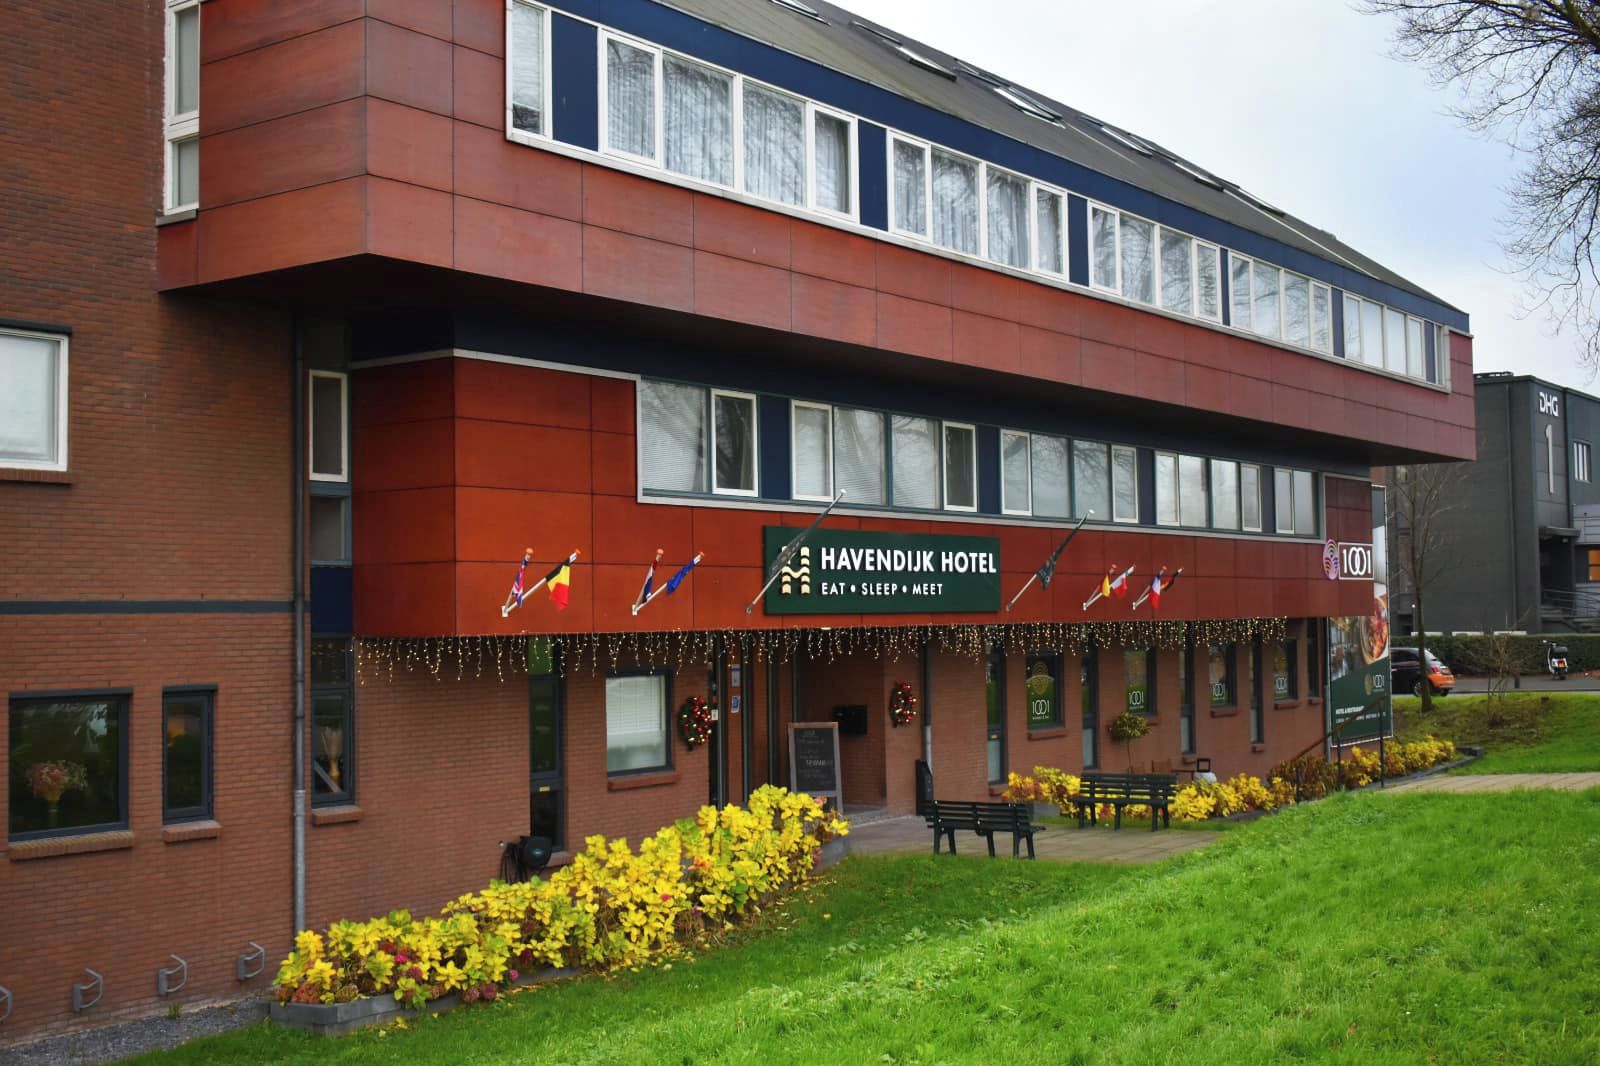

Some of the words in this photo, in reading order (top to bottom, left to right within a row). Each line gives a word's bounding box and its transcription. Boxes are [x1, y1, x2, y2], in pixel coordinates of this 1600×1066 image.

[1539, 391, 1559, 417] DHG
[821, 547, 935, 572] HAVENDIJK
[941, 551, 997, 573] HOTEL
[1342, 546, 1371, 576] 1001
[821, 582, 846, 595] EAT
[861, 583, 898, 595] SLEEP
[912, 583, 943, 595] MEET
[1032, 699, 1050, 715] 1001
